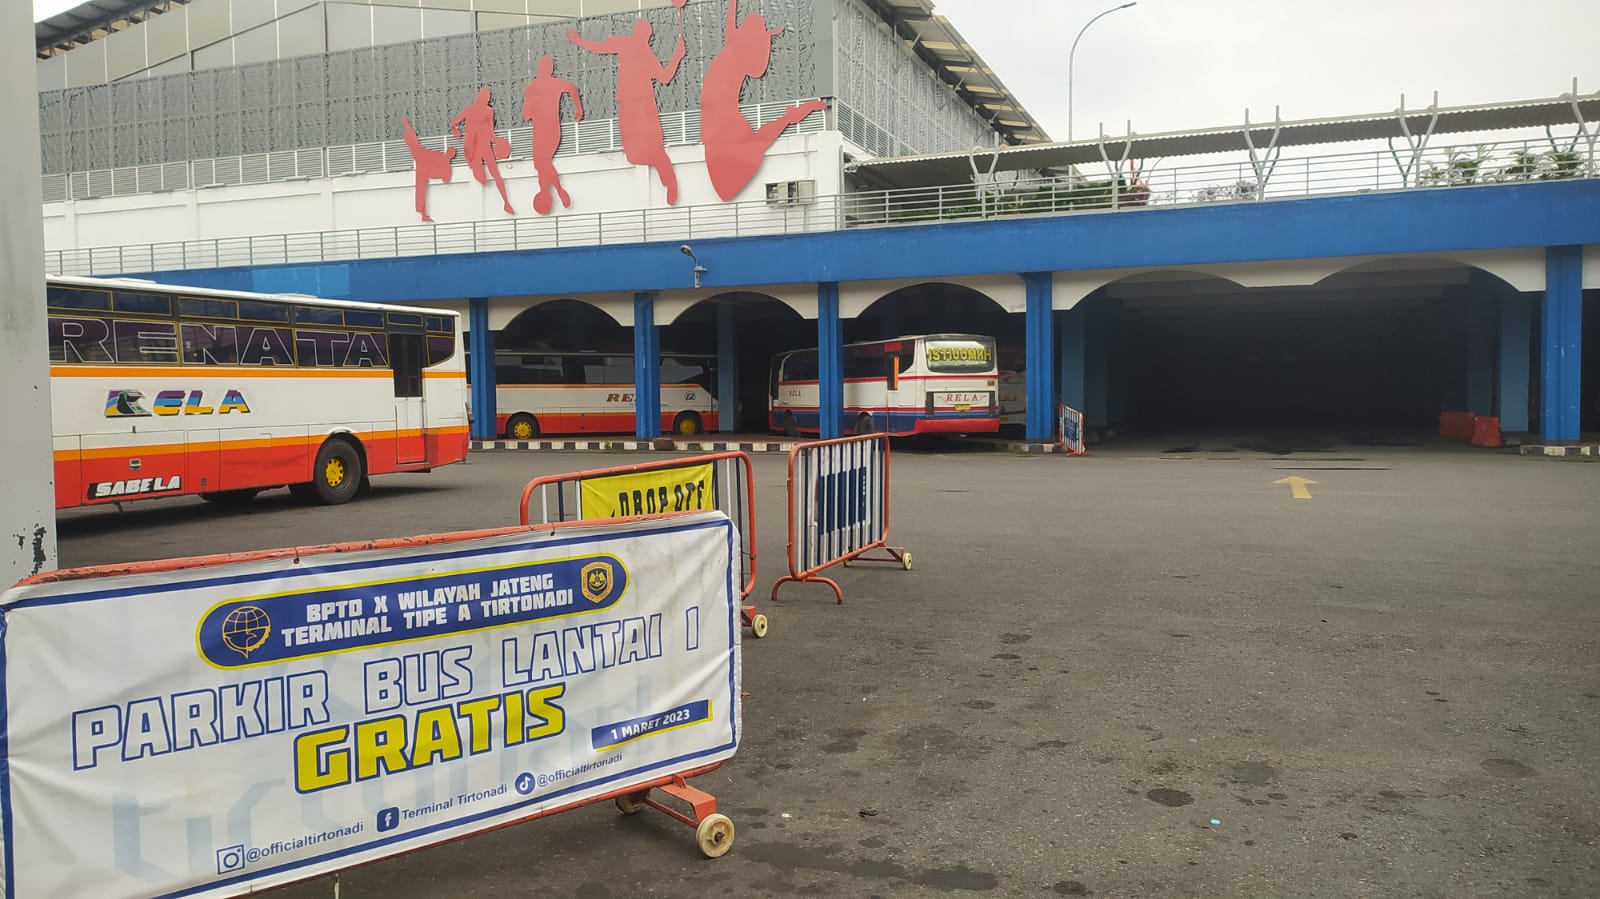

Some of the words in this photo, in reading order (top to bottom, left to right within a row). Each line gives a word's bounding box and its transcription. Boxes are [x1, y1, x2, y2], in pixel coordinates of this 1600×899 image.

[48, 317, 389, 366] RENATA
[946, 393, 979, 402] RELA
[89, 475, 181, 499] SABELA
[618, 486, 668, 517] DROP
[281, 615, 393, 647] TERMINAL
[403, 606, 448, 630] TIPE
[457, 604, 472, 621] A
[480, 589, 574, 618] TIRTONADI
[306, 598, 363, 623] BPTD
[374, 595, 389, 613] X
[397, 583, 481, 611] WILAYAH
[490, 573, 554, 598] JATENG
[72, 669, 330, 771] PARKIR
[363, 645, 473, 715] BUS
[502, 612, 662, 688] LANTAI
[293, 681, 566, 795] GRATIS
[611, 728, 619, 741] 1
[621, 717, 662, 738] MARET
[662, 708, 691, 727] 2023
[536, 752, 624, 788] @officialtirtonadi
[400, 796, 453, 821] Terminal
[456, 783, 508, 806] Tirtonadi
[246, 820, 365, 864] @officialtirtonadi
